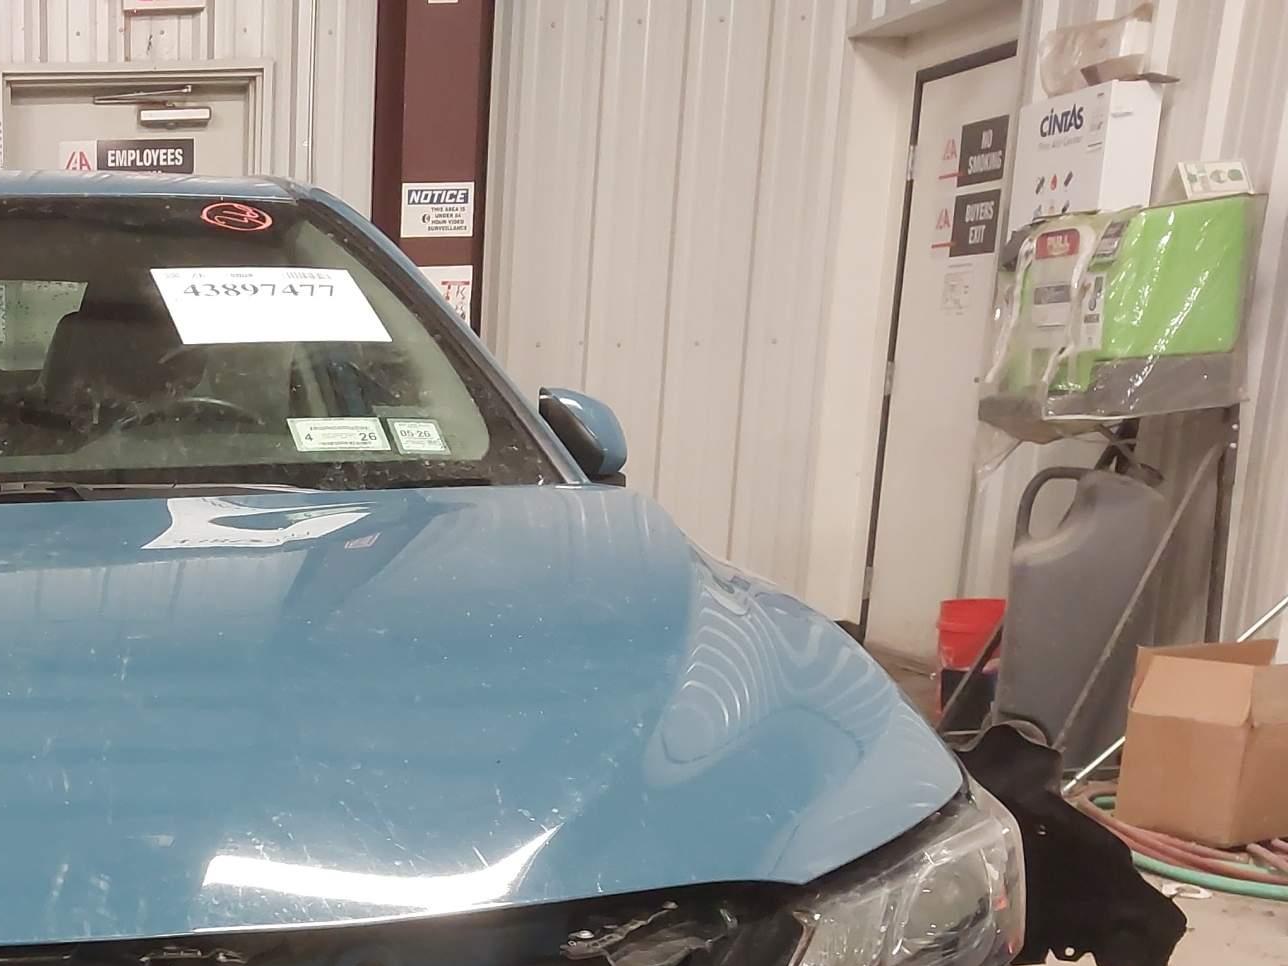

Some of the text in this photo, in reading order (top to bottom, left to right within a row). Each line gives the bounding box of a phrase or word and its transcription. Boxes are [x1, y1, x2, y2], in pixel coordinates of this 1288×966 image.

[1039, 104, 1084, 137] CINTAS
[980, 129, 993, 149] NO
[107, 148, 184, 167] EMPLOYEES
[967, 150, 1002, 175] SMOKING
[409, 190, 466, 203] NOTICE
[965, 201, 995, 222] BUYERS
[968, 225, 986, 244] EXIT
[184, 284, 334, 296] 43897477
[359, 432, 377, 441] 26
